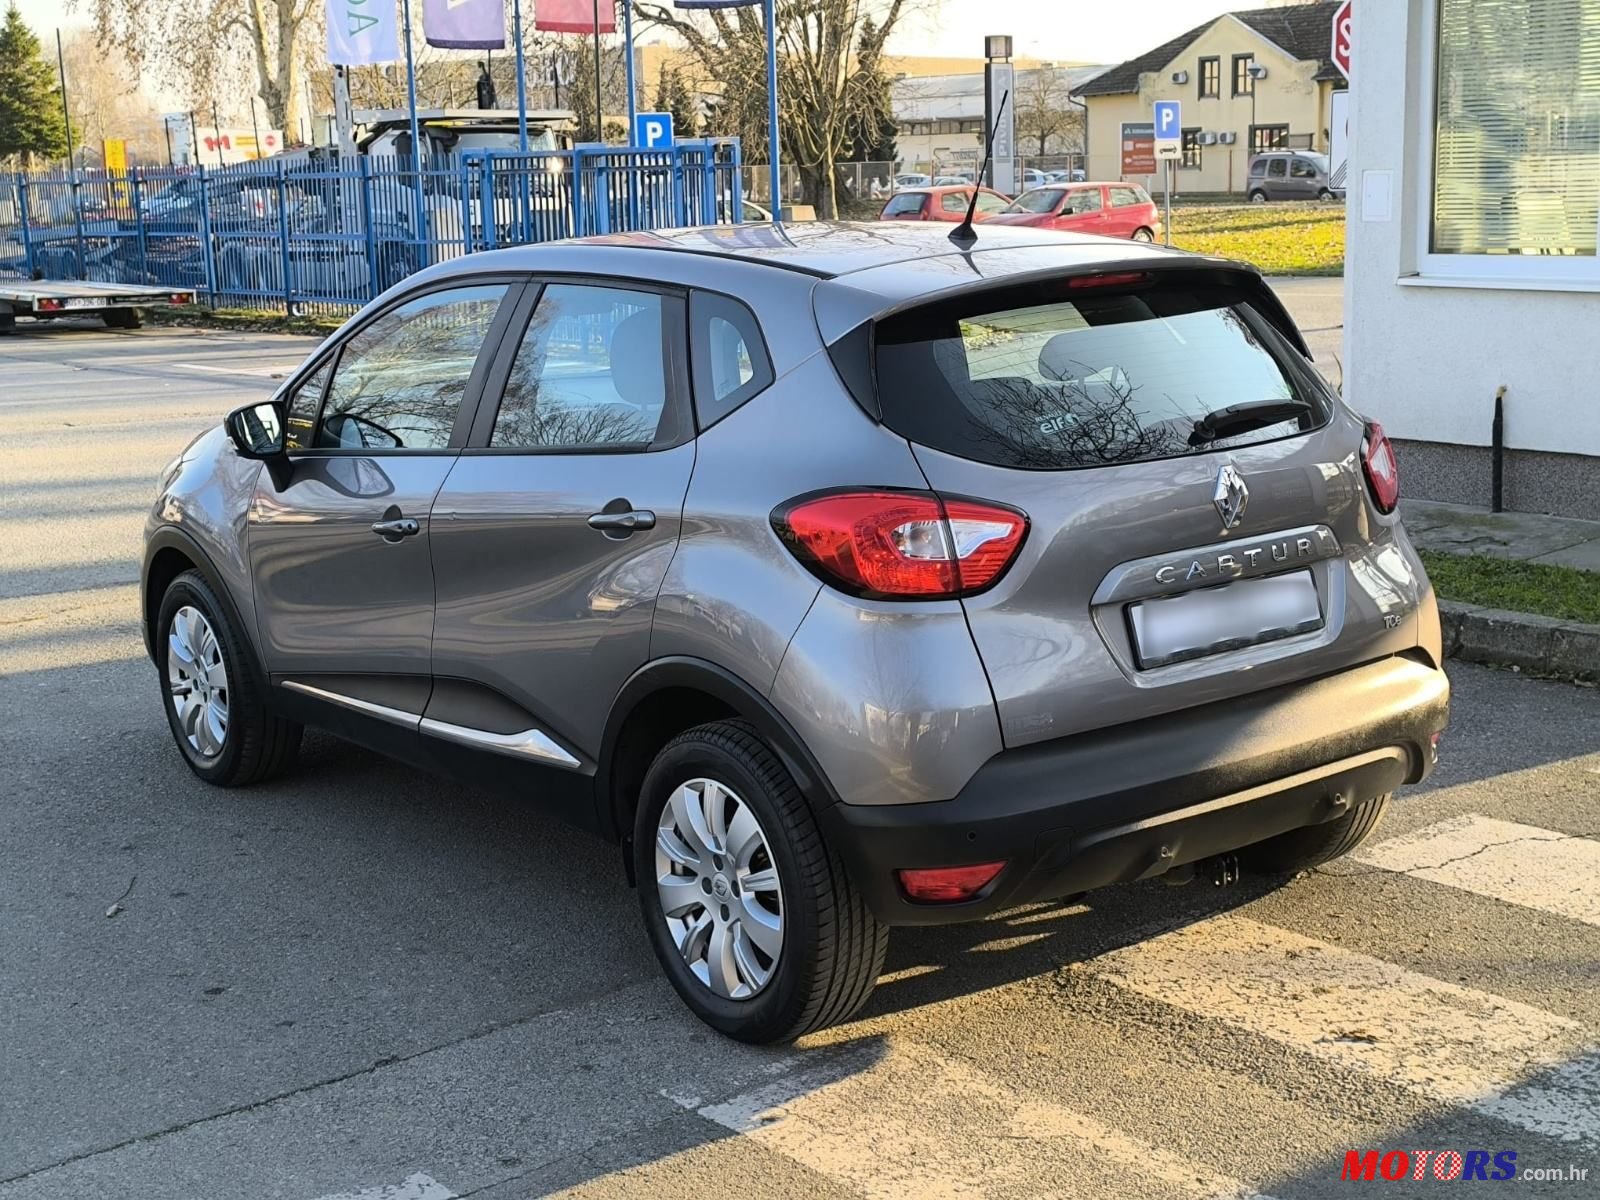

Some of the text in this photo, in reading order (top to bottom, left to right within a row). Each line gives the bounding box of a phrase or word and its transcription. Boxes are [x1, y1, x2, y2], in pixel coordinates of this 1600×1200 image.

[1162, 108, 1173, 131] P
[646, 121, 663, 147] P
[1040, 416, 1065, 434] elf
[1155, 538, 1312, 583] CAPTUR
